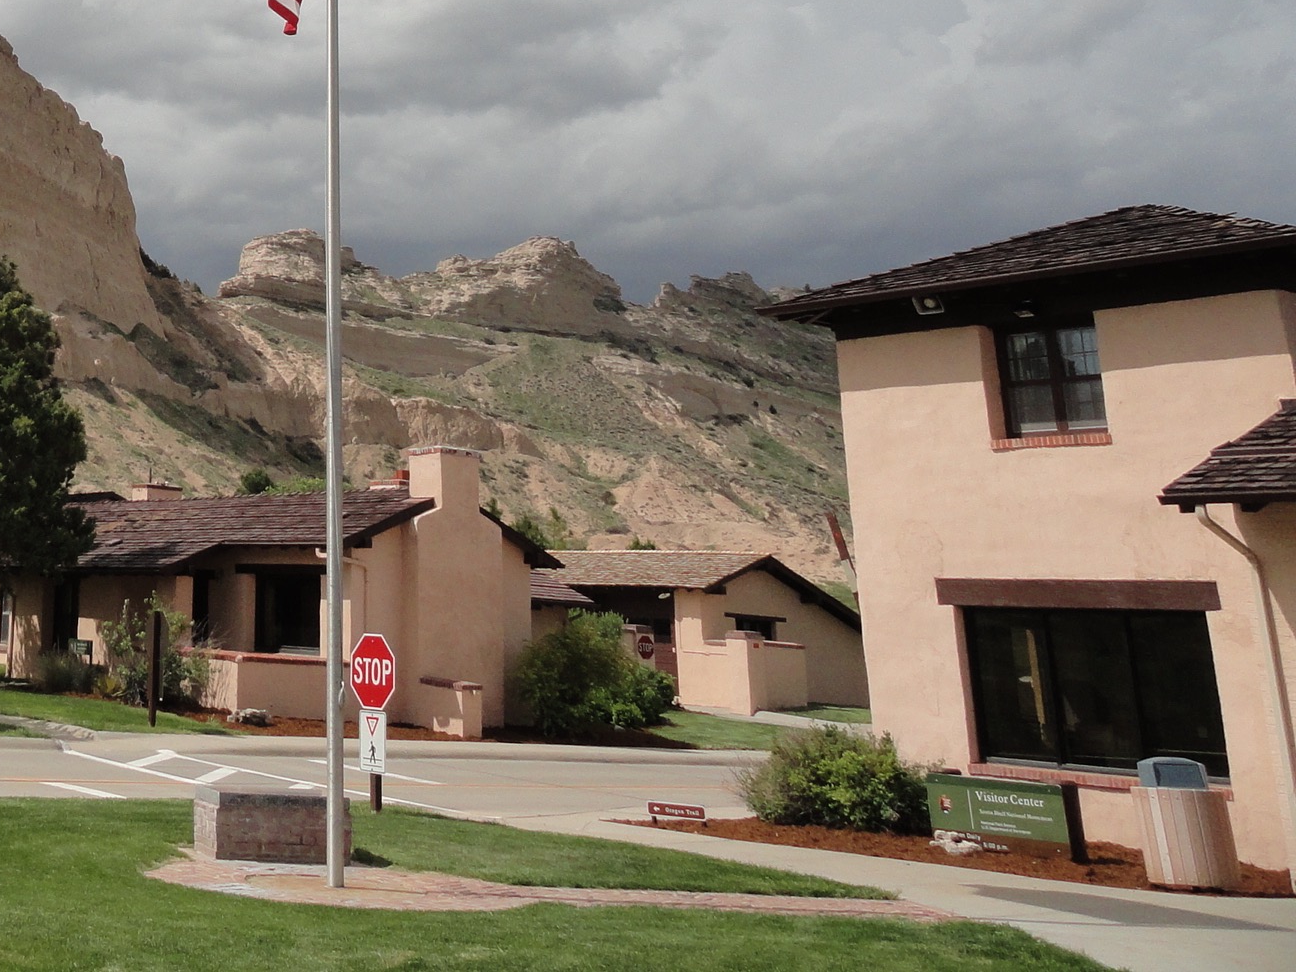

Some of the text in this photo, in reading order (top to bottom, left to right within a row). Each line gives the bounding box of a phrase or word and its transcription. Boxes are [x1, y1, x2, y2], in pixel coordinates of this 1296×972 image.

[639, 643, 652, 652] STOP
[354, 657, 391, 685] STOP
[975, 791, 1044, 807] Visitor Center
[664, 806, 700, 816] Oregon Trail
